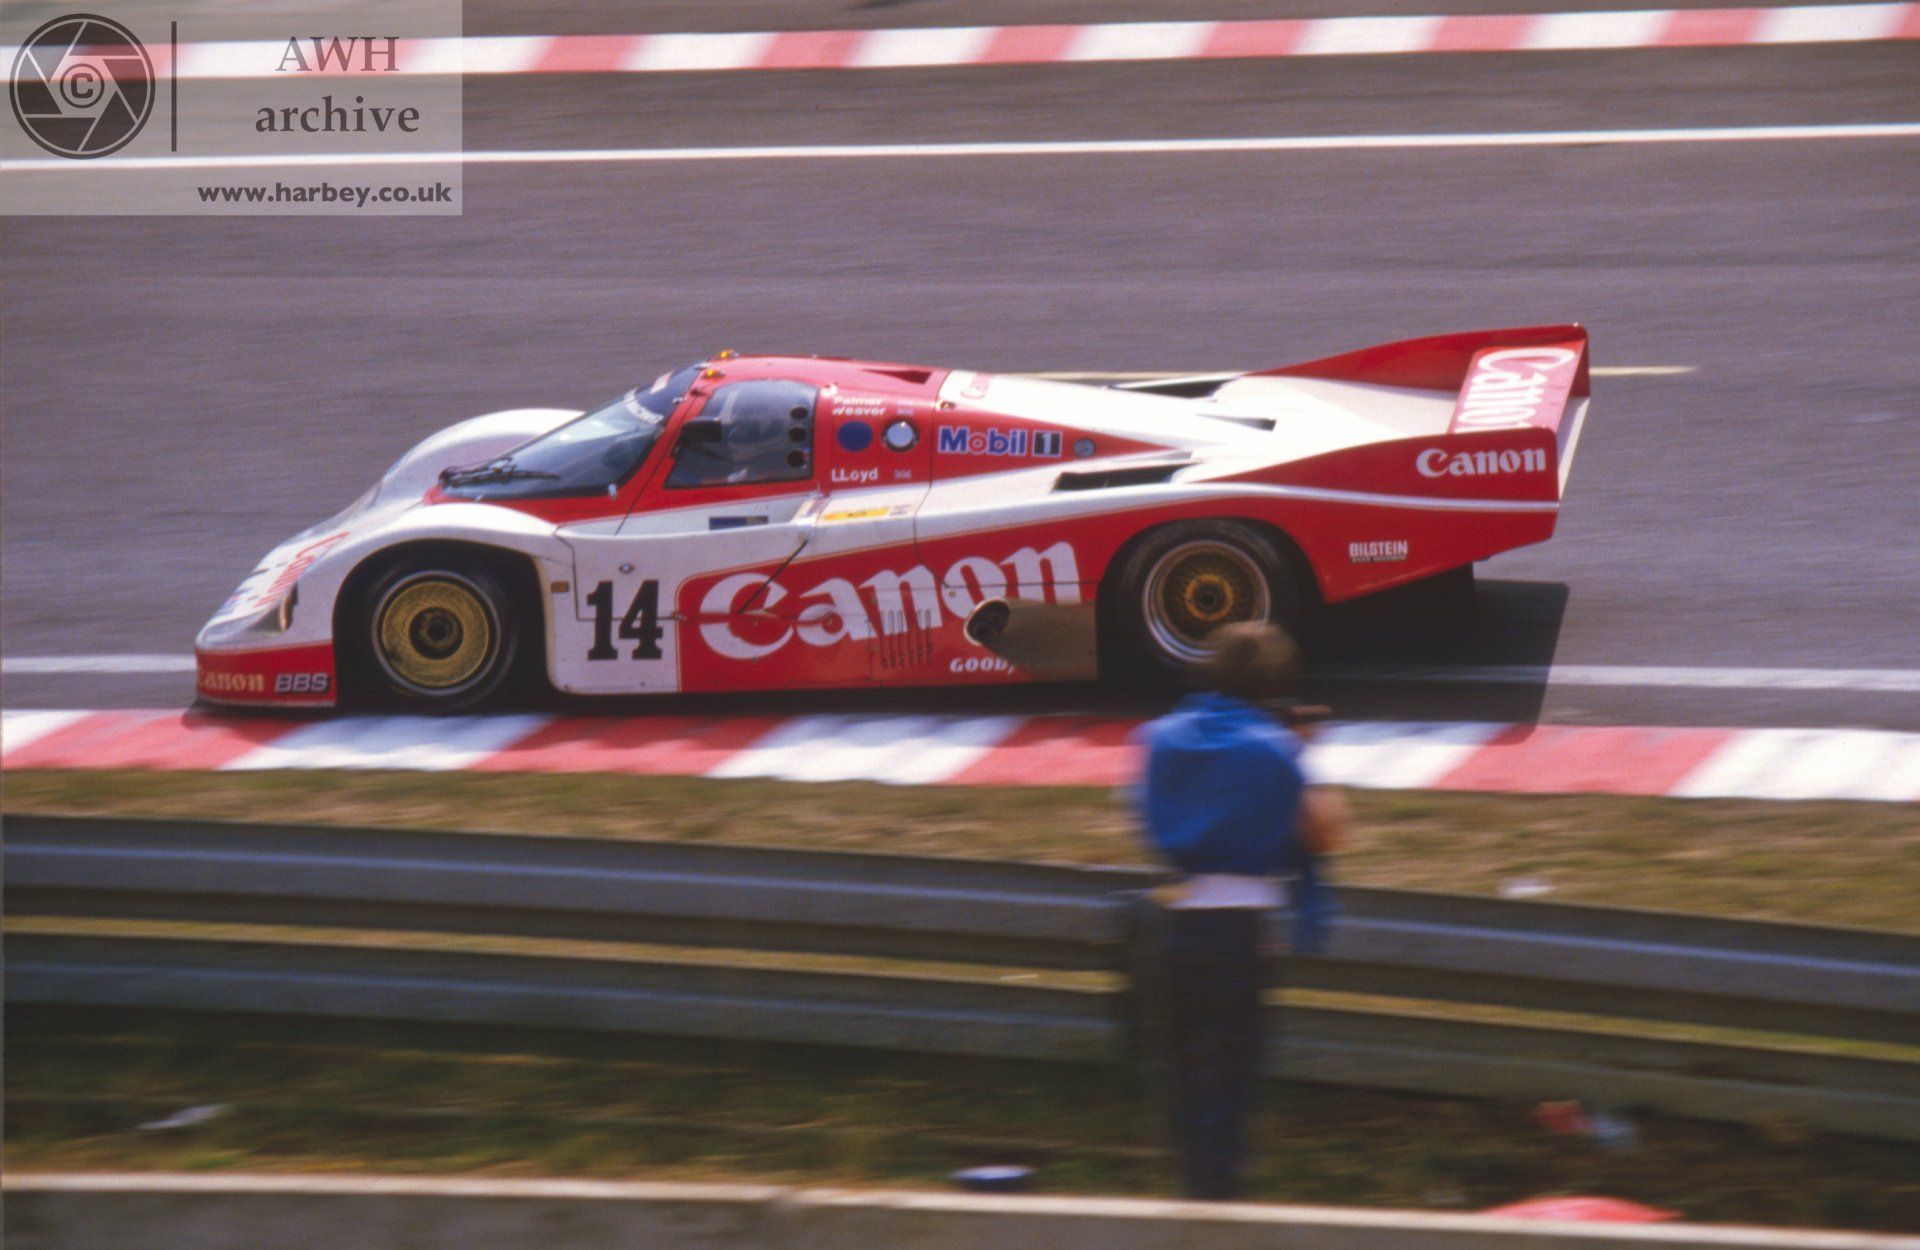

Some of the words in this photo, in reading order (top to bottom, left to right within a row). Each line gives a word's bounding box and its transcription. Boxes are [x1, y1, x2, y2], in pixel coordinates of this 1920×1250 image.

[938, 425, 1027, 456] Mobil
[1415, 448, 1547, 478] Canon
[1349, 540, 1408, 557] BILSTEIN
[699, 541, 1082, 660] Canon
[586, 579, 664, 661] 14
[199, 664, 264, 692] anon
[949, 656, 1016, 676] GOOD
[275, 672, 330, 692] BBS
